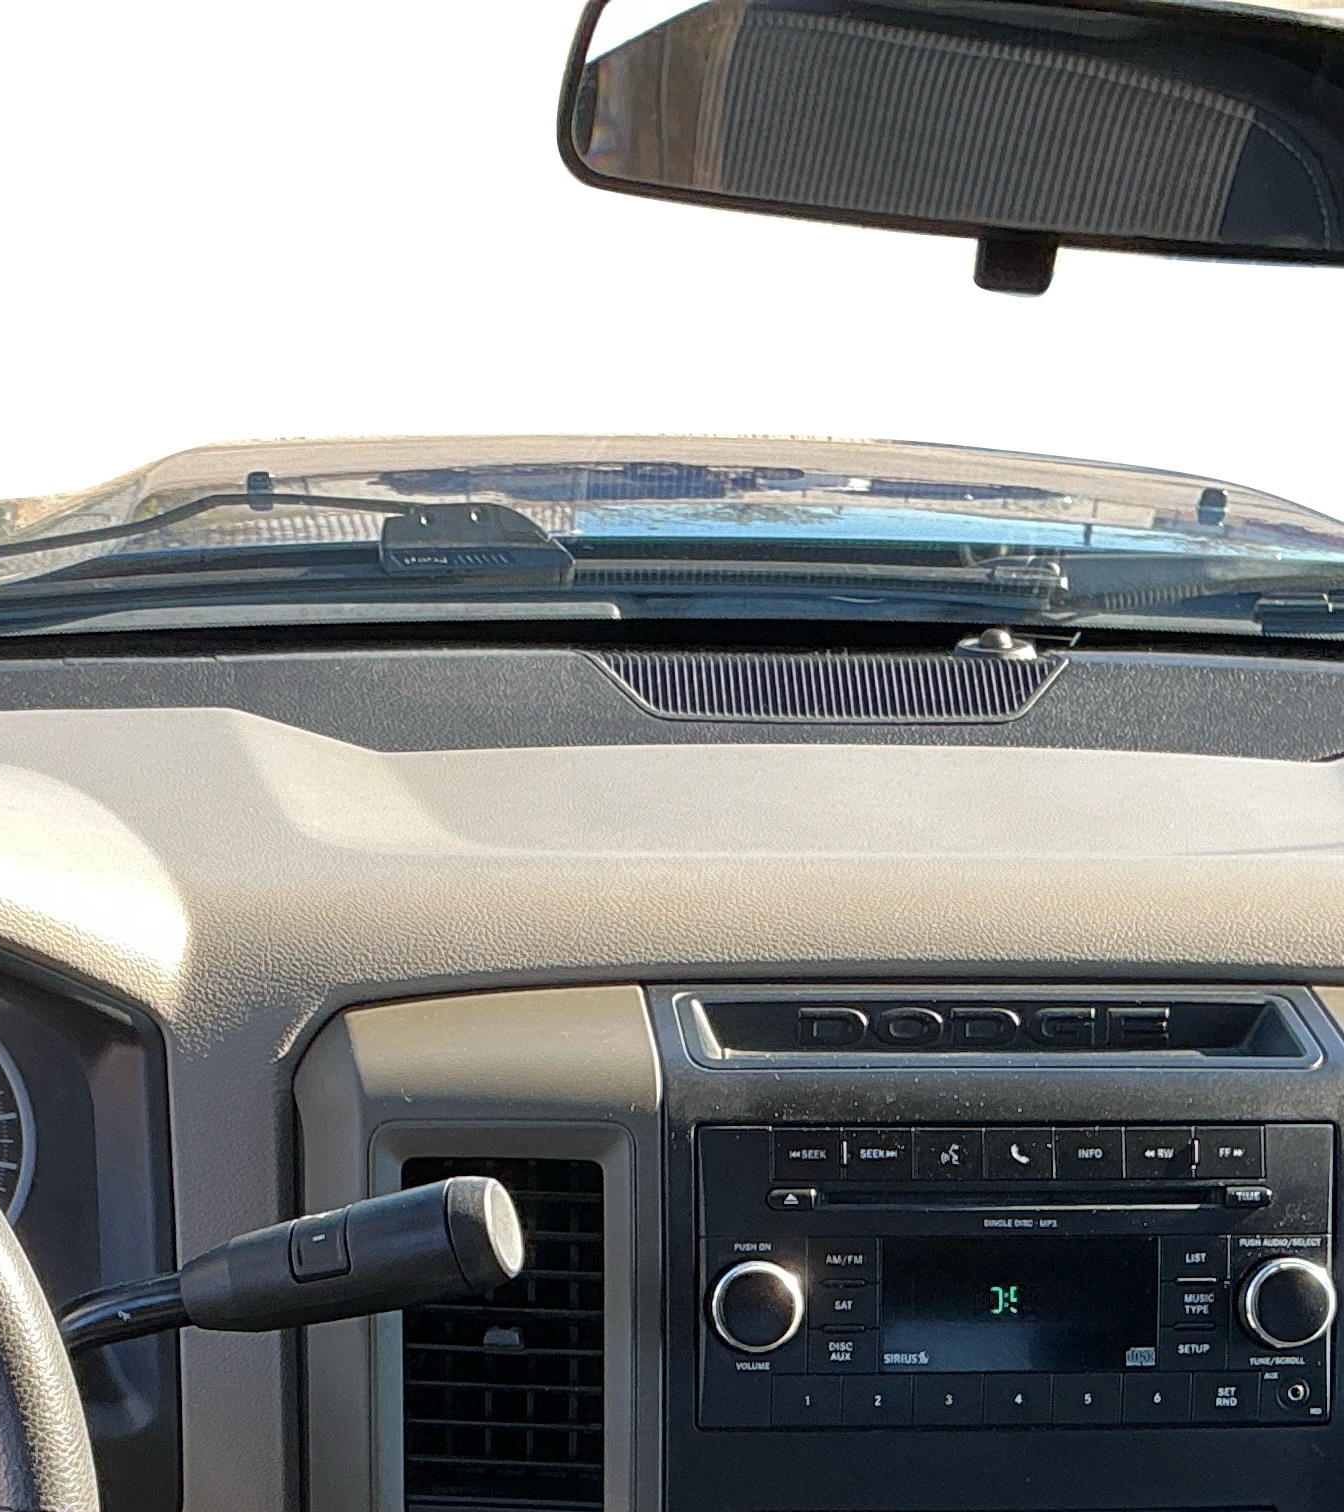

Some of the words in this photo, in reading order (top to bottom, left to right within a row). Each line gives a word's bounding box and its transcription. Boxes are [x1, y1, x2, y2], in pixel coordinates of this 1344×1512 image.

[797, 1006, 1171, 1047] DODGE
[801, 1150, 827, 1160] SEEK
[859, 1149, 885, 1160] SEEK
[1077, 1148, 1103, 1159] INFO
[1218, 1147, 1232, 1158] FF
[734, 1243, 757, 1251] PUSH
[759, 1243, 772, 1251] ON
[1239, 1238, 1262, 1247] PUSH
[1263, 1237, 1322, 1247] AUDIO/SELECT
[825, 1254, 864, 1266] AM/FM
[1185, 1252, 1207, 1264] LIST
[1184, 1293, 1215, 1304] MUSIC
[834, 1300, 853, 1311] SAT
[1184, 1304, 1209, 1315] TYPE
[828, 1341, 854, 1352] DISC
[1177, 1344, 1210, 1355] SETUP
[829, 1352, 852, 1361] AUX
[883, 1353, 918, 1365] SIRIUS
[1249, 1356, 1306, 1367] TUNE/SCROLL
[736, 1362, 771, 1371] VOLUME
[1217, 1387, 1236, 1397] SET
[804, 1396, 811, 1407] 1
[874, 1395, 882, 1407] 2
[945, 1394, 953, 1406] 3
[1014, 1393, 1024, 1405] 4
[1084, 1393, 1092, 1405] 5
[1153, 1392, 1162, 1404] 6
[1215, 1397, 1238, 1407] RND
